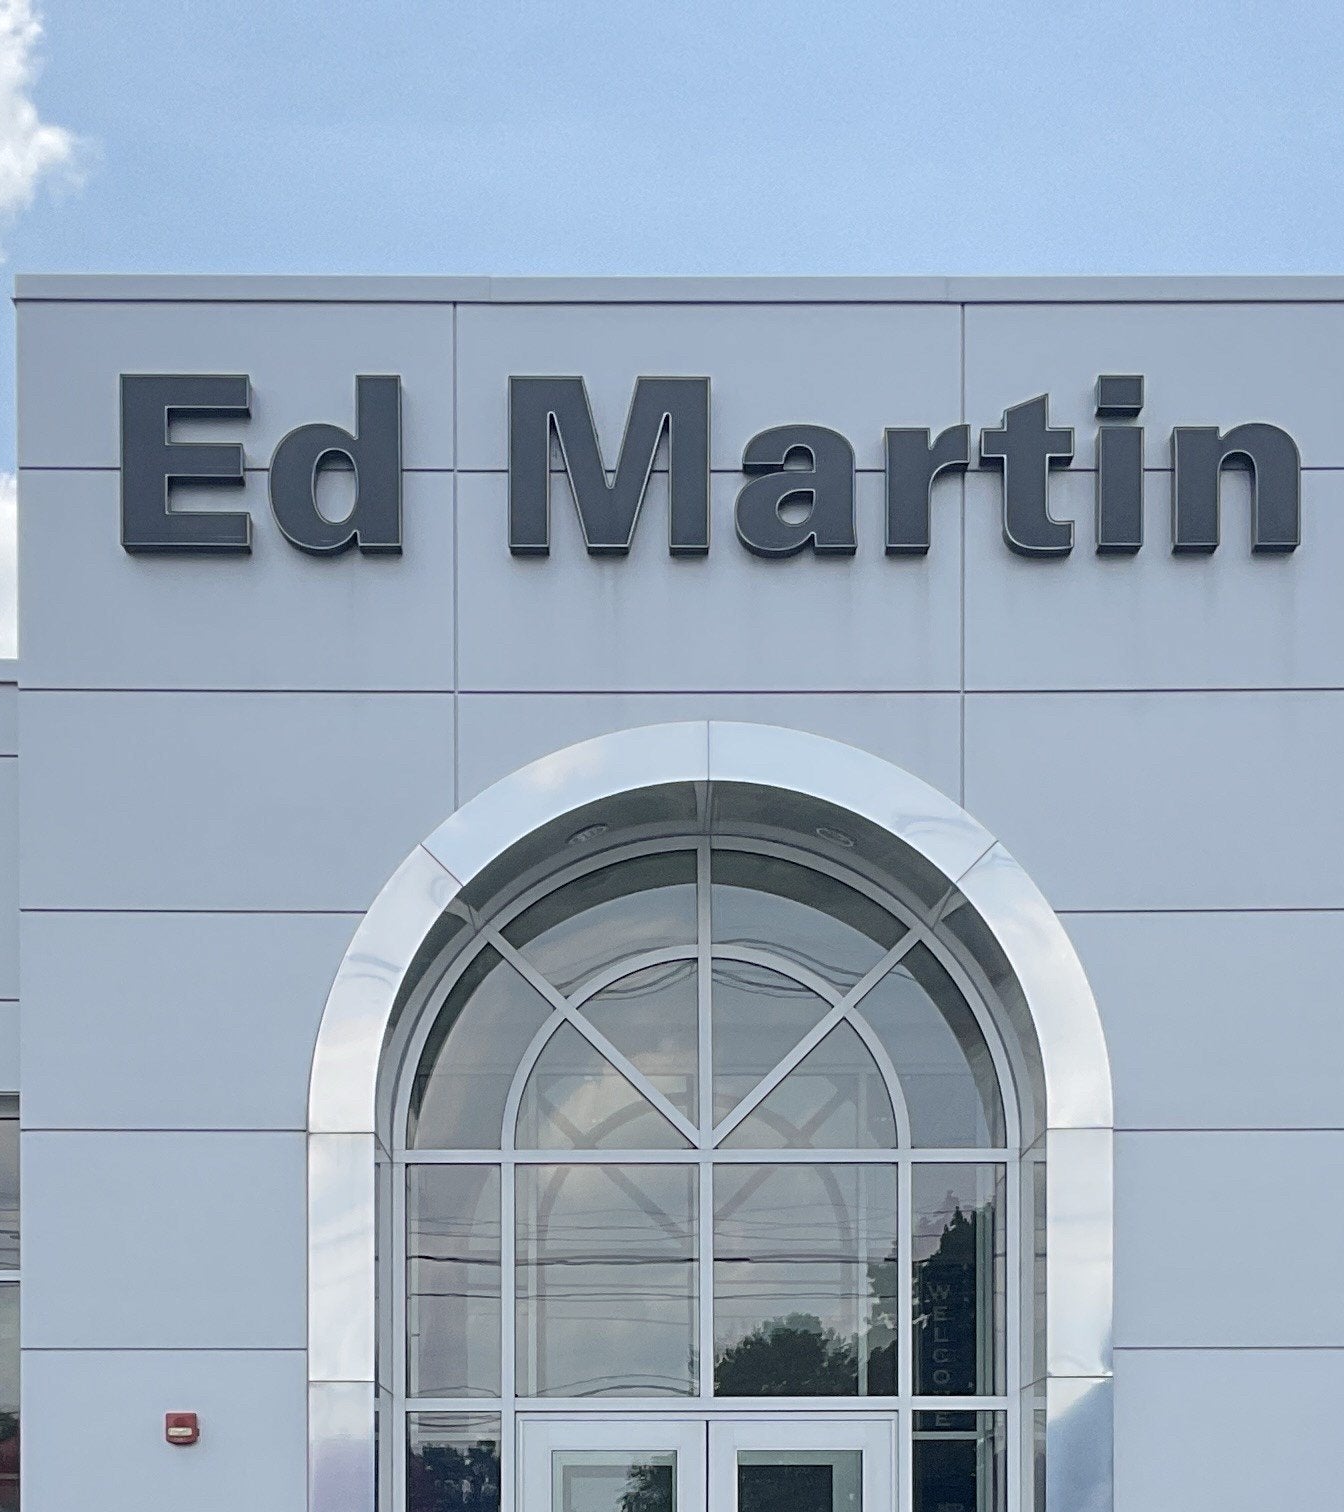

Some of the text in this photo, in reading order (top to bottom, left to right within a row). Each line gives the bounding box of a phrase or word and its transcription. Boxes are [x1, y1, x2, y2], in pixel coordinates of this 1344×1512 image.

[118, 372, 1303, 567] Ed Martin
[928, 1281, 954, 1428] WELCOE
